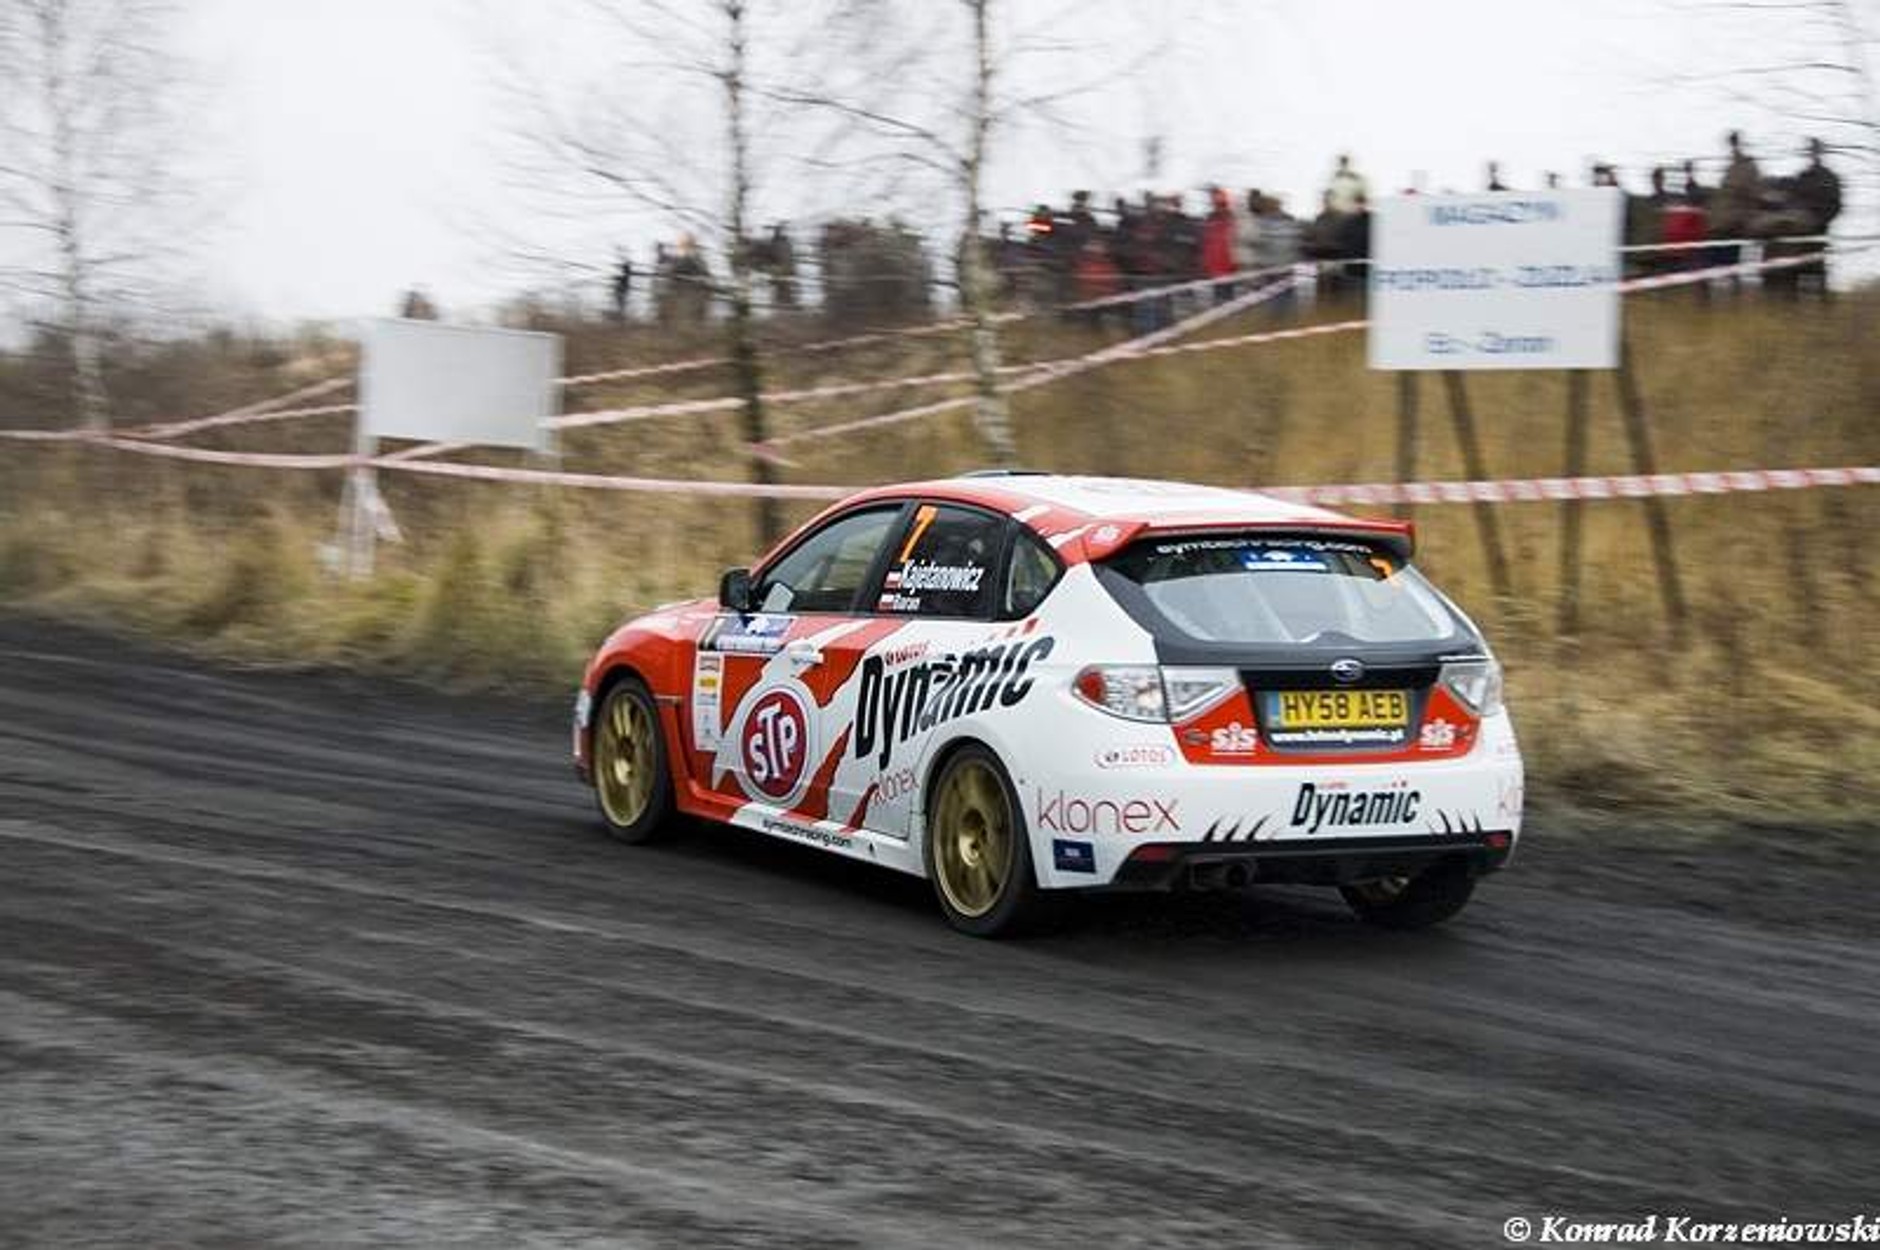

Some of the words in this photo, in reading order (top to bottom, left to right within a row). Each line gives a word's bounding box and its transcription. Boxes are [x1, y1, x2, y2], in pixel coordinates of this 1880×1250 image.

[901, 505, 937, 563] 7
[856, 636, 1054, 771] Dynamic
[1283, 692, 1350, 721] HY58
[1358, 692, 1404, 719] AEB
[750, 702, 797, 782] STP
[1038, 787, 1180, 833] klonex
[1291, 782, 1420, 834] Dynamic
